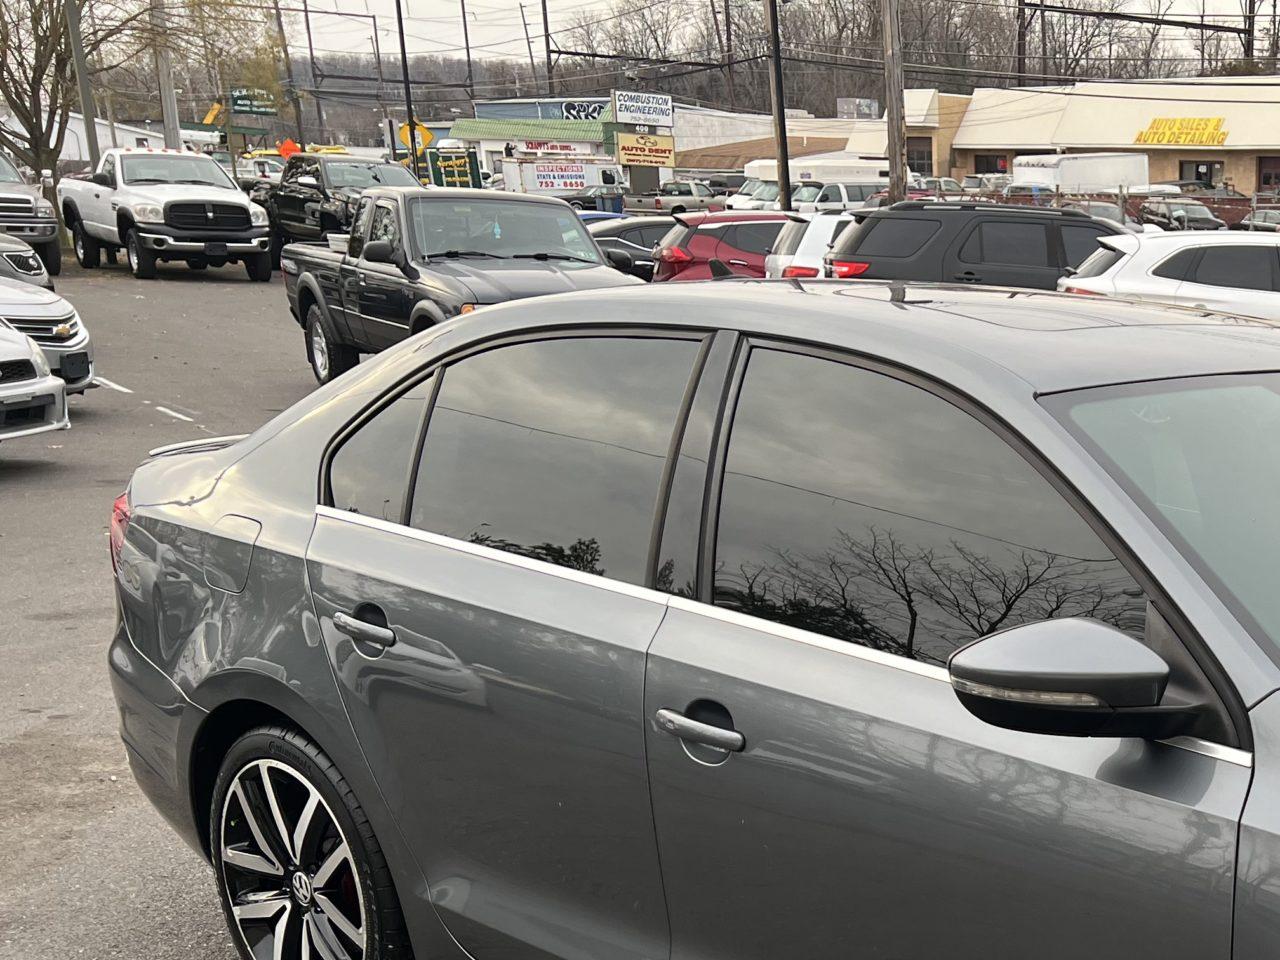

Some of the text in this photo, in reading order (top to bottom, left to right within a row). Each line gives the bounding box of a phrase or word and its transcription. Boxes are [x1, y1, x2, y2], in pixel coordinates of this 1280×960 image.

[617, 93, 670, 106] COMBUSTION
[618, 103, 671, 116] ENGINEERING
[1148, 117, 1222, 131] AUTO SALES &
[1134, 131, 1226, 145] AUTO DETAILING
[535, 165, 584, 173] INSPECTIONS
